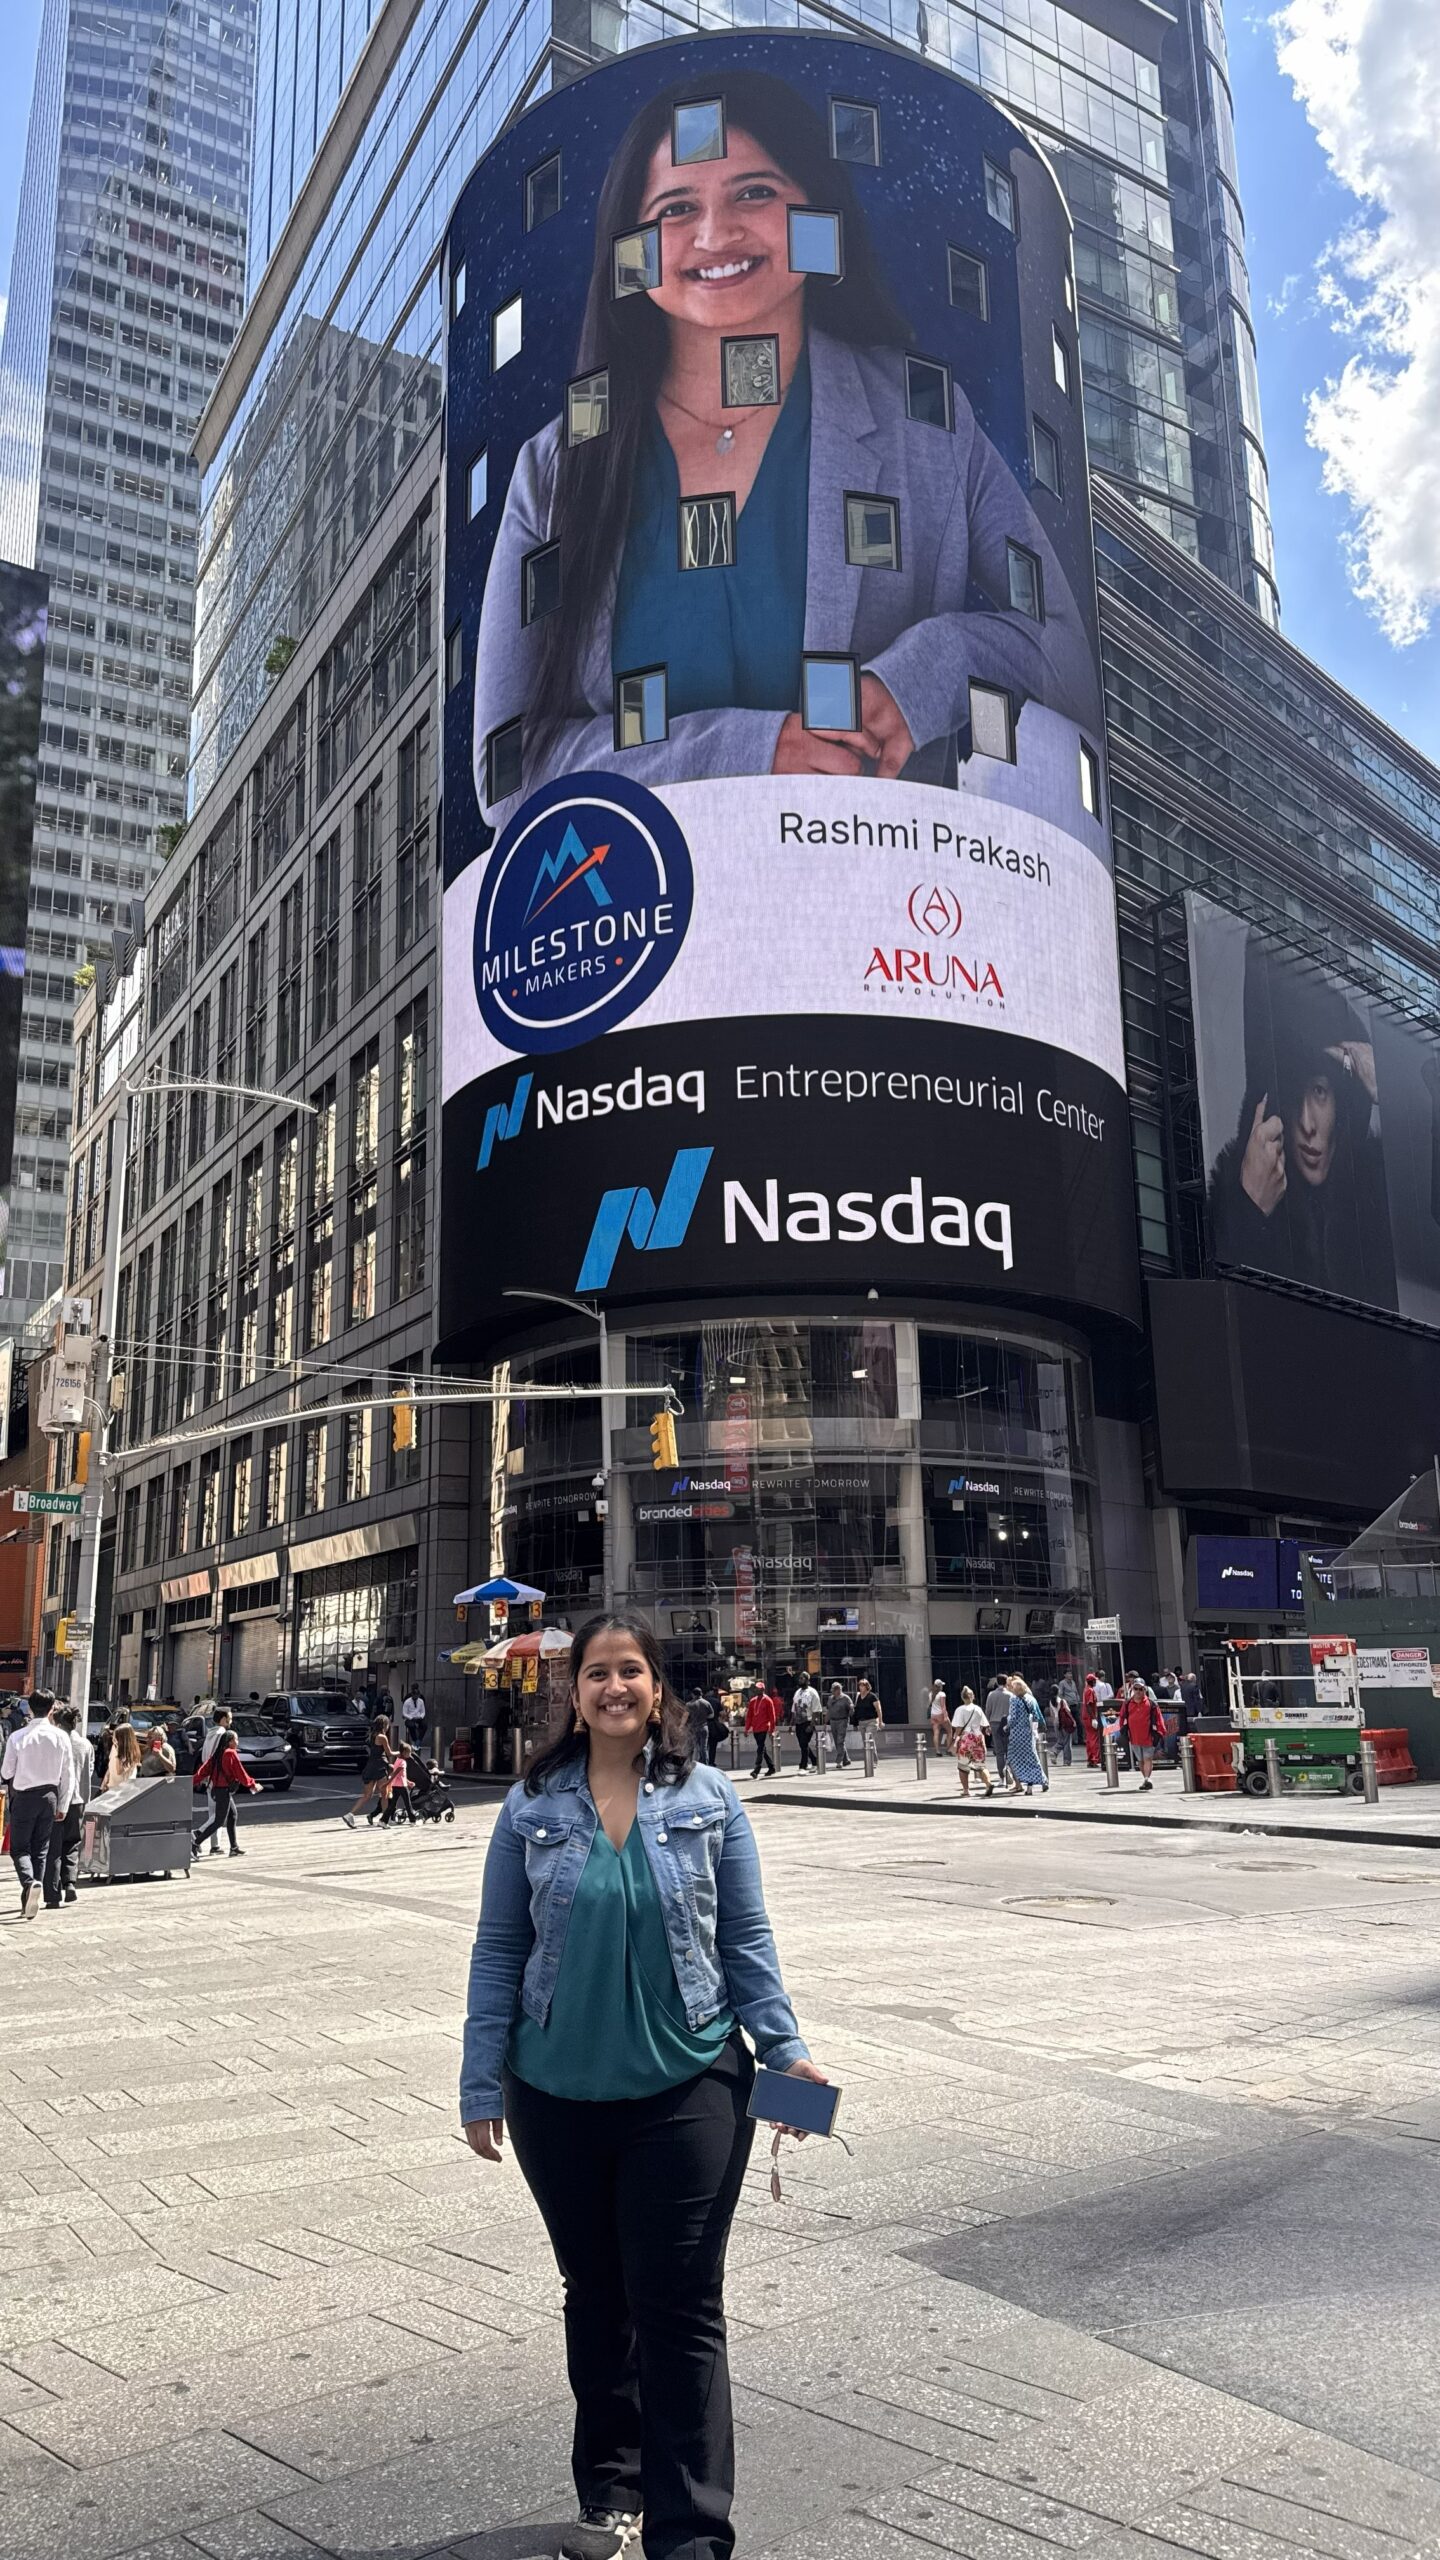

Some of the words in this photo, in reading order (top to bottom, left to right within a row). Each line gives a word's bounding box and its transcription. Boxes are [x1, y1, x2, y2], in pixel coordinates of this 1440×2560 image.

[780, 812, 918, 850] Rashmi
[933, 822, 1051, 886] Prakash
[482, 903, 674, 990] MILESTONE
[526, 955, 606, 996] MAKERS
[864, 947, 1004, 998] ARUNA
[864, 984, 1005, 1010] REVOLUTION
[537, 1066, 705, 1129] Nasdaq
[736, 1064, 1023, 1115] Entrepreneurial
[1037, 1089, 1105, 1142] Center
[724, 1176, 1014, 1271] Nasdaq
[56, 1378, 81, 1388] 726156
[690, 1480, 731, 1492] Nasdaq
[752, 1478, 801, 1489] REWRITE
[806, 1478, 870, 1488] TOMORROW
[965, 1481, 1000, 1495] Nasdaq
[1014, 1487, 1044, 1499] REWRITE
[29, 1495, 79, 1514] Broadway
[495, 1600, 506, 1616] 3
[1356, 1656, 1388, 1669] EDESTRIANS
[1394, 1651, 1422, 1659] DANGER
[527, 1658, 537, 1678] 2
